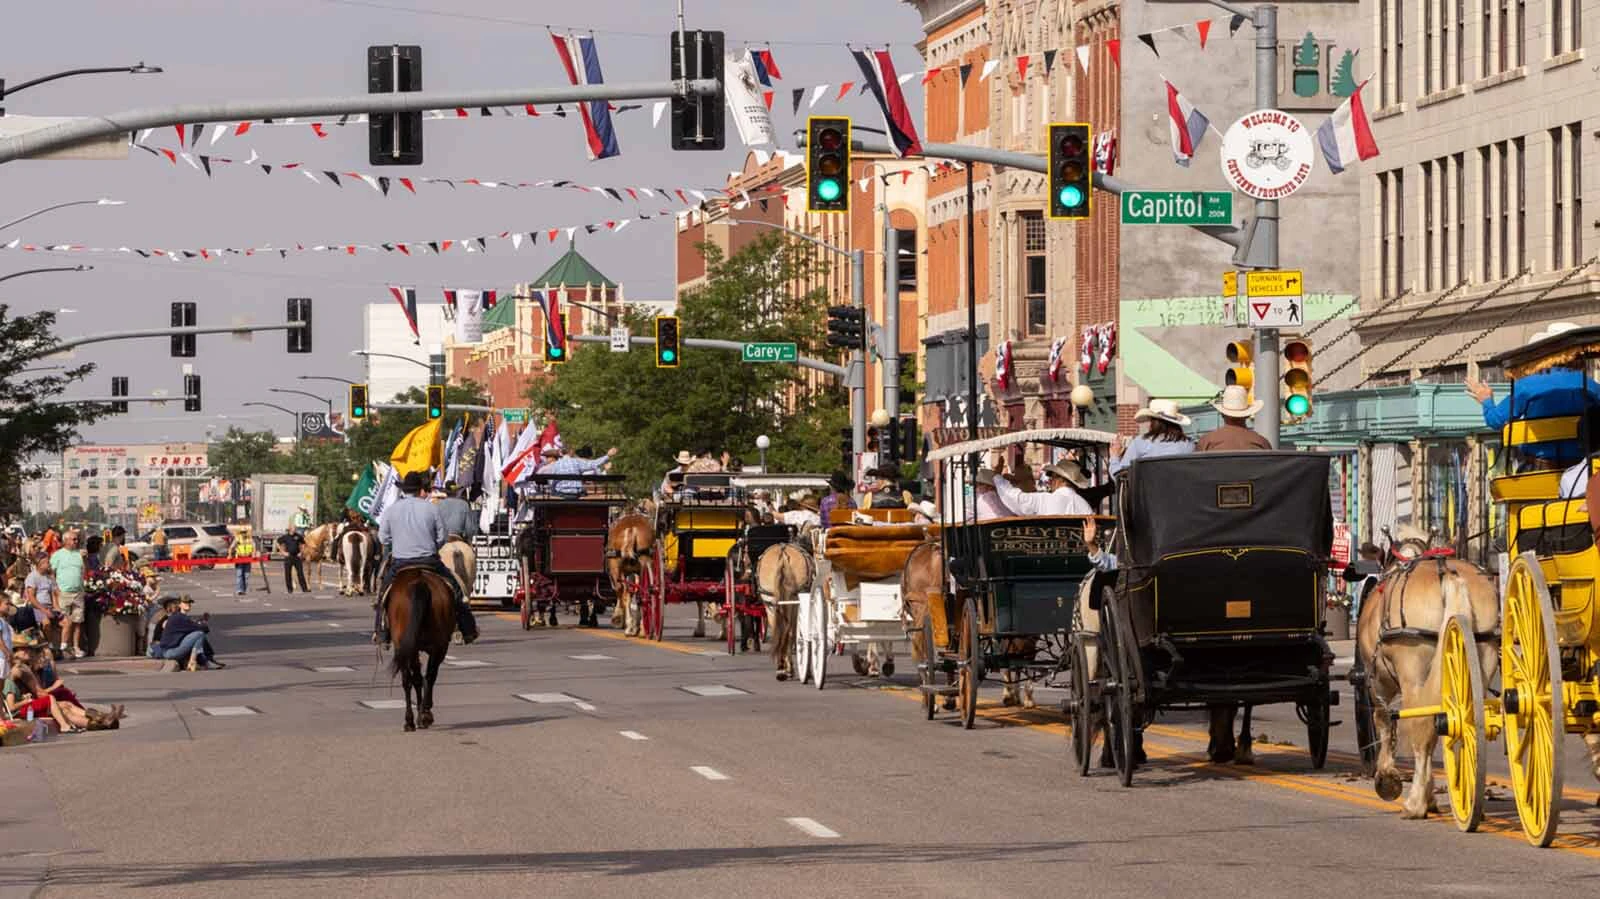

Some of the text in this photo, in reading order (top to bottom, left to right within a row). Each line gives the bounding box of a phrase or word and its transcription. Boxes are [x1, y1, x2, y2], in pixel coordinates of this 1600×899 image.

[1241, 112, 1300, 133] WELCOME TO
[1226, 159, 1311, 198] CHEYENNE FRONTIER DAYS
[1128, 193, 1202, 223] Capitol
[746, 344, 782, 361] Carey
[150, 457, 203, 465] SANDS
